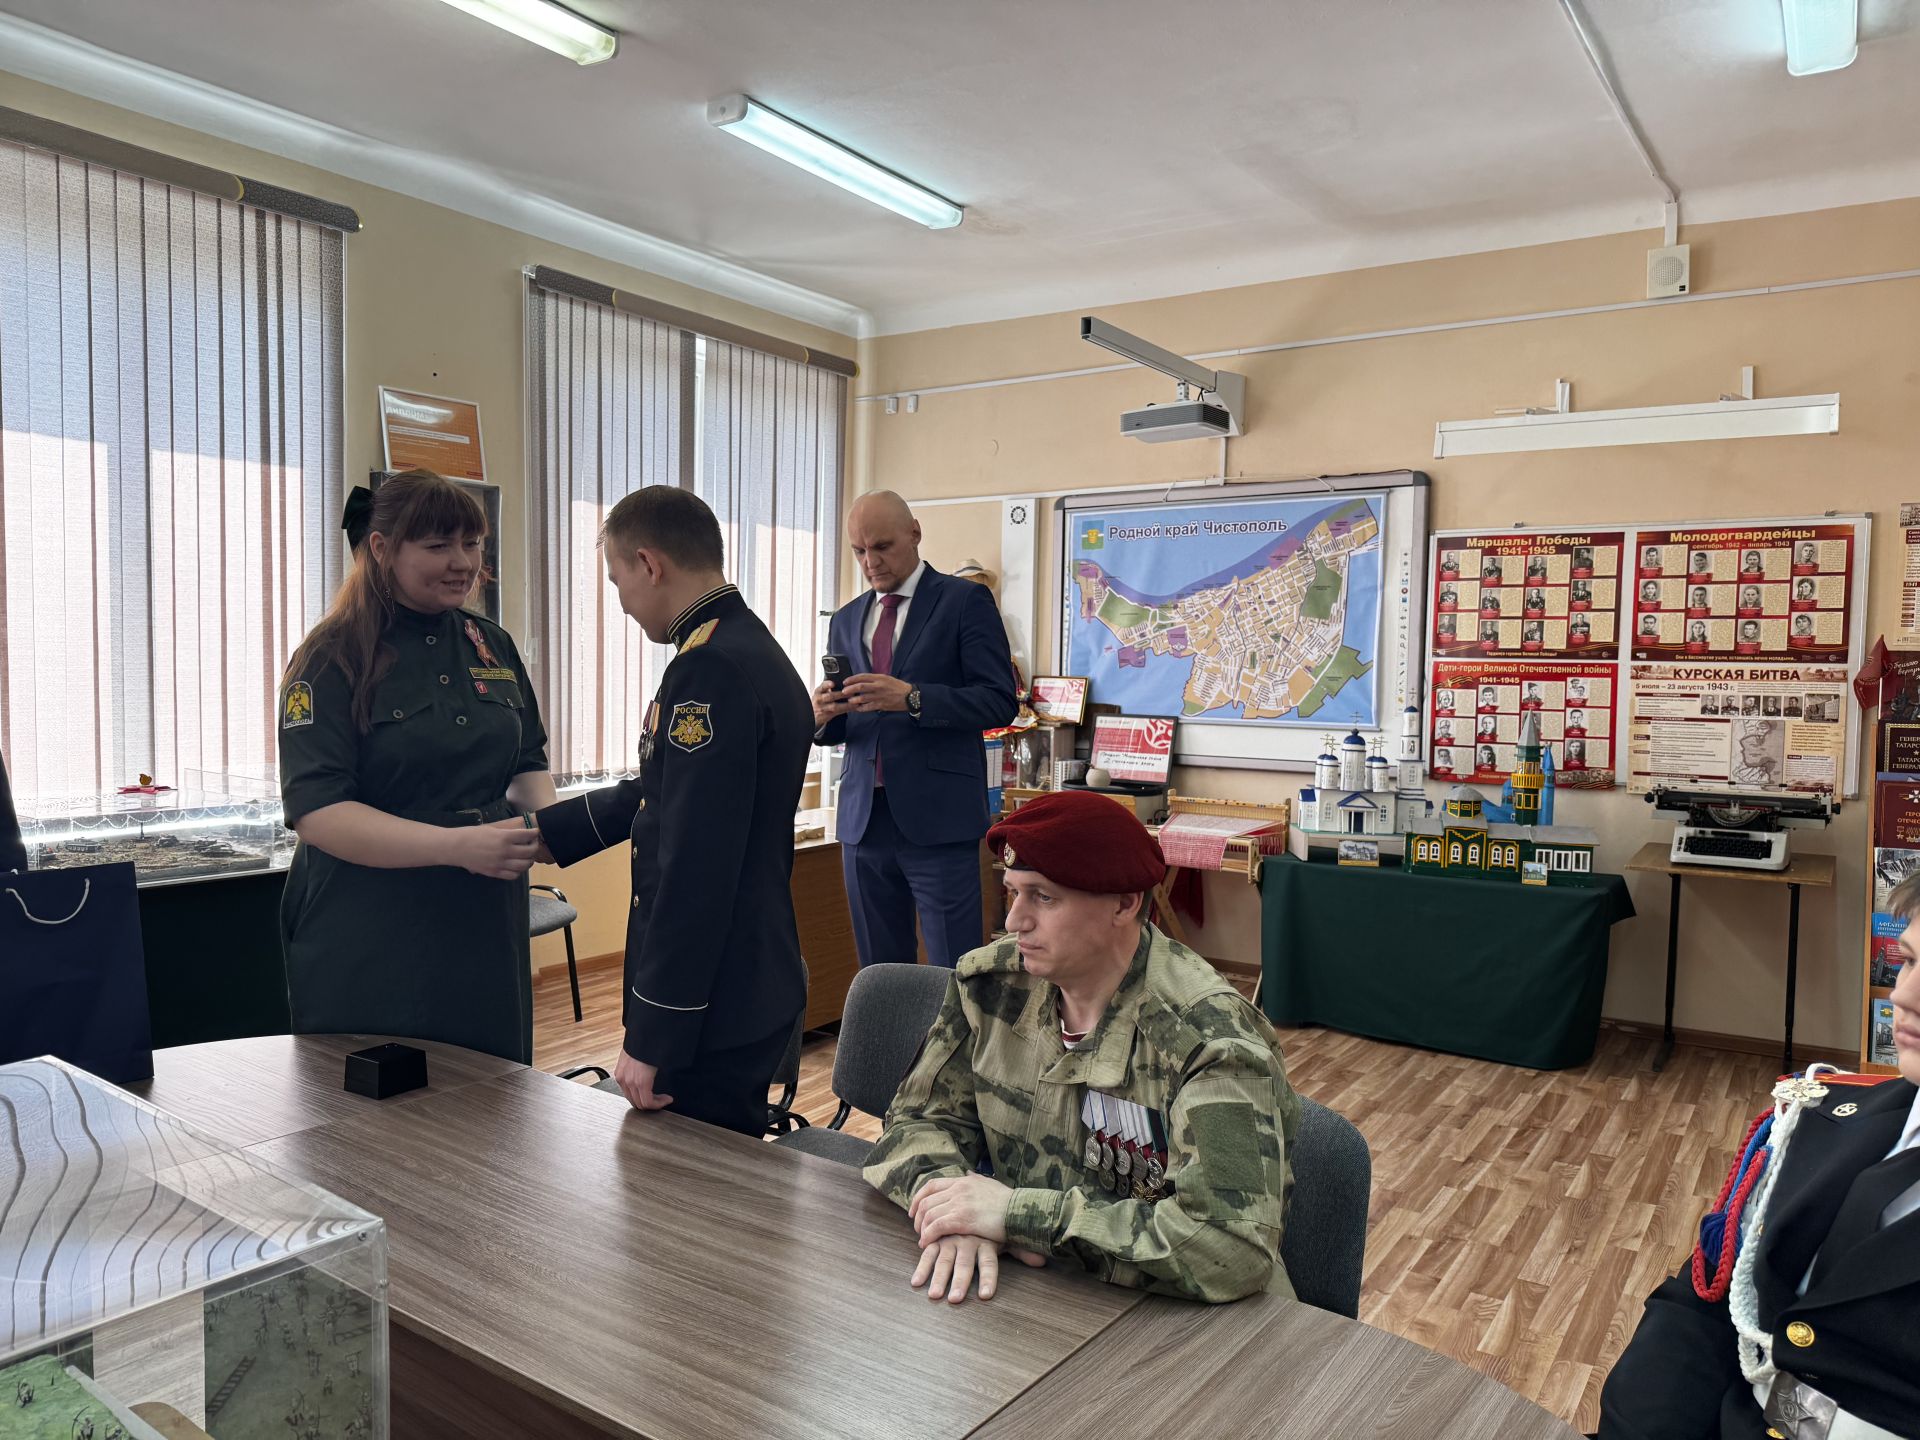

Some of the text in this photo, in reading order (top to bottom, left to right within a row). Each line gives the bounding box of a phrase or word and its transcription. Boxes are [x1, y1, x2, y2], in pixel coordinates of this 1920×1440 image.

[1109, 519, 1287, 540] Родной край Чистополь
[1670, 528, 1816, 543] Молодогвардейцы
[1466, 535, 1591, 548] Маршалы Победы
[1692, 542, 1723, 550] сентябрь
[1437, 663, 1612, 674] Дети-герои Великой Отечественной войны
[1673, 668, 1801, 681] КУРСКАЯ БИТВА
[1707, 682, 1729, 691] 1943
[675, 706, 707, 714] РОССИЯ
